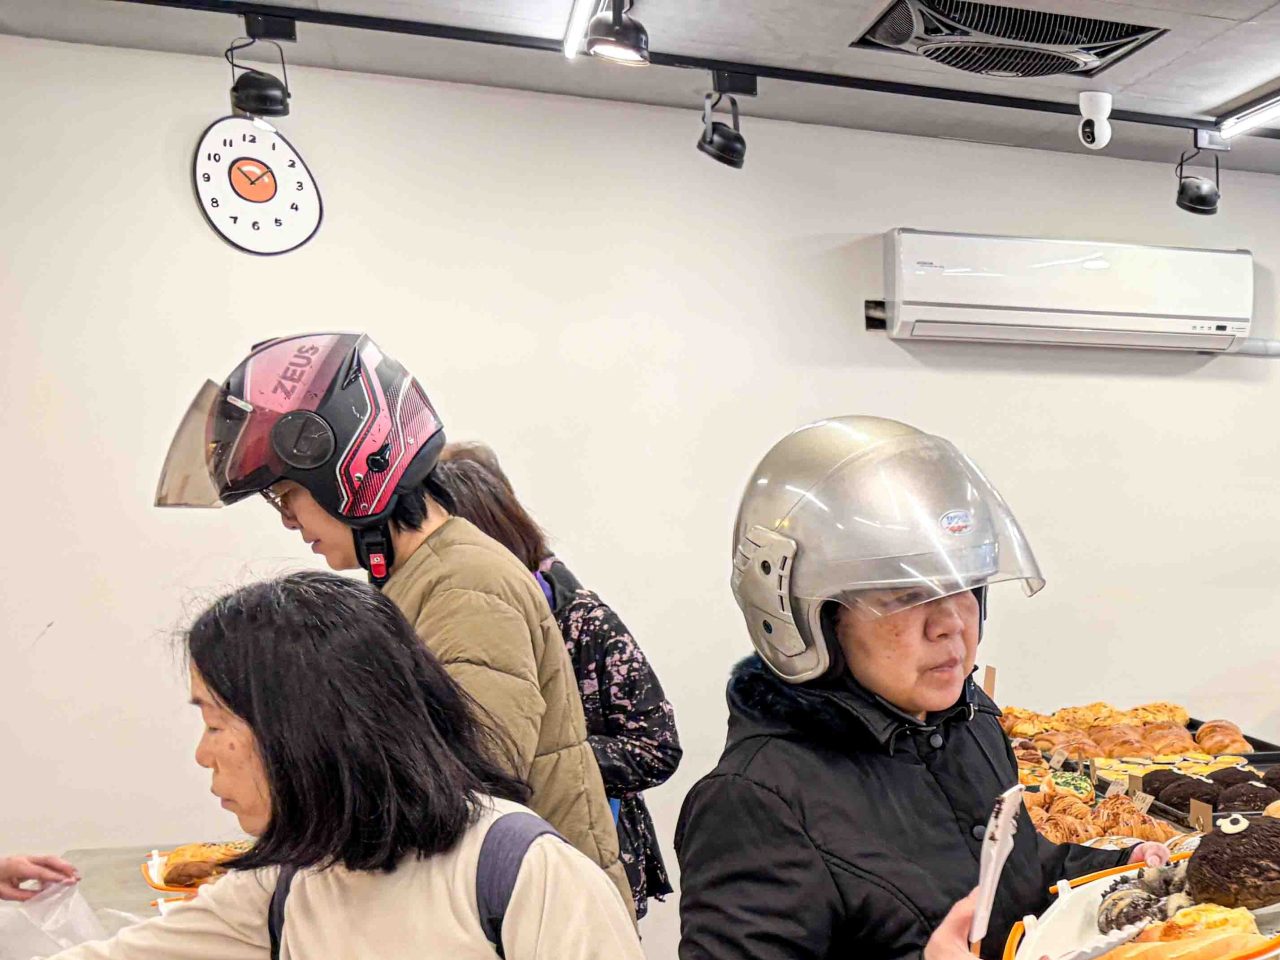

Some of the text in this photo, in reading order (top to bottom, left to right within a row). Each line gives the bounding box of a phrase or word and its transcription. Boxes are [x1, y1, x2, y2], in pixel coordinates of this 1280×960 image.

[223, 138, 233, 148] 11
[242, 133, 257, 143] 12
[207, 153, 221, 163] 10
[288, 159, 296, 168] 2
[202, 172, 211, 182] 9
[296, 181, 304, 191] 3
[211, 197, 219, 208] 8
[290, 202, 299, 212] 4
[229, 215, 238, 224] 7
[274, 217, 283, 227] 5
[251, 221, 261, 231] 6
[272, 344, 320, 400] ZEUS
